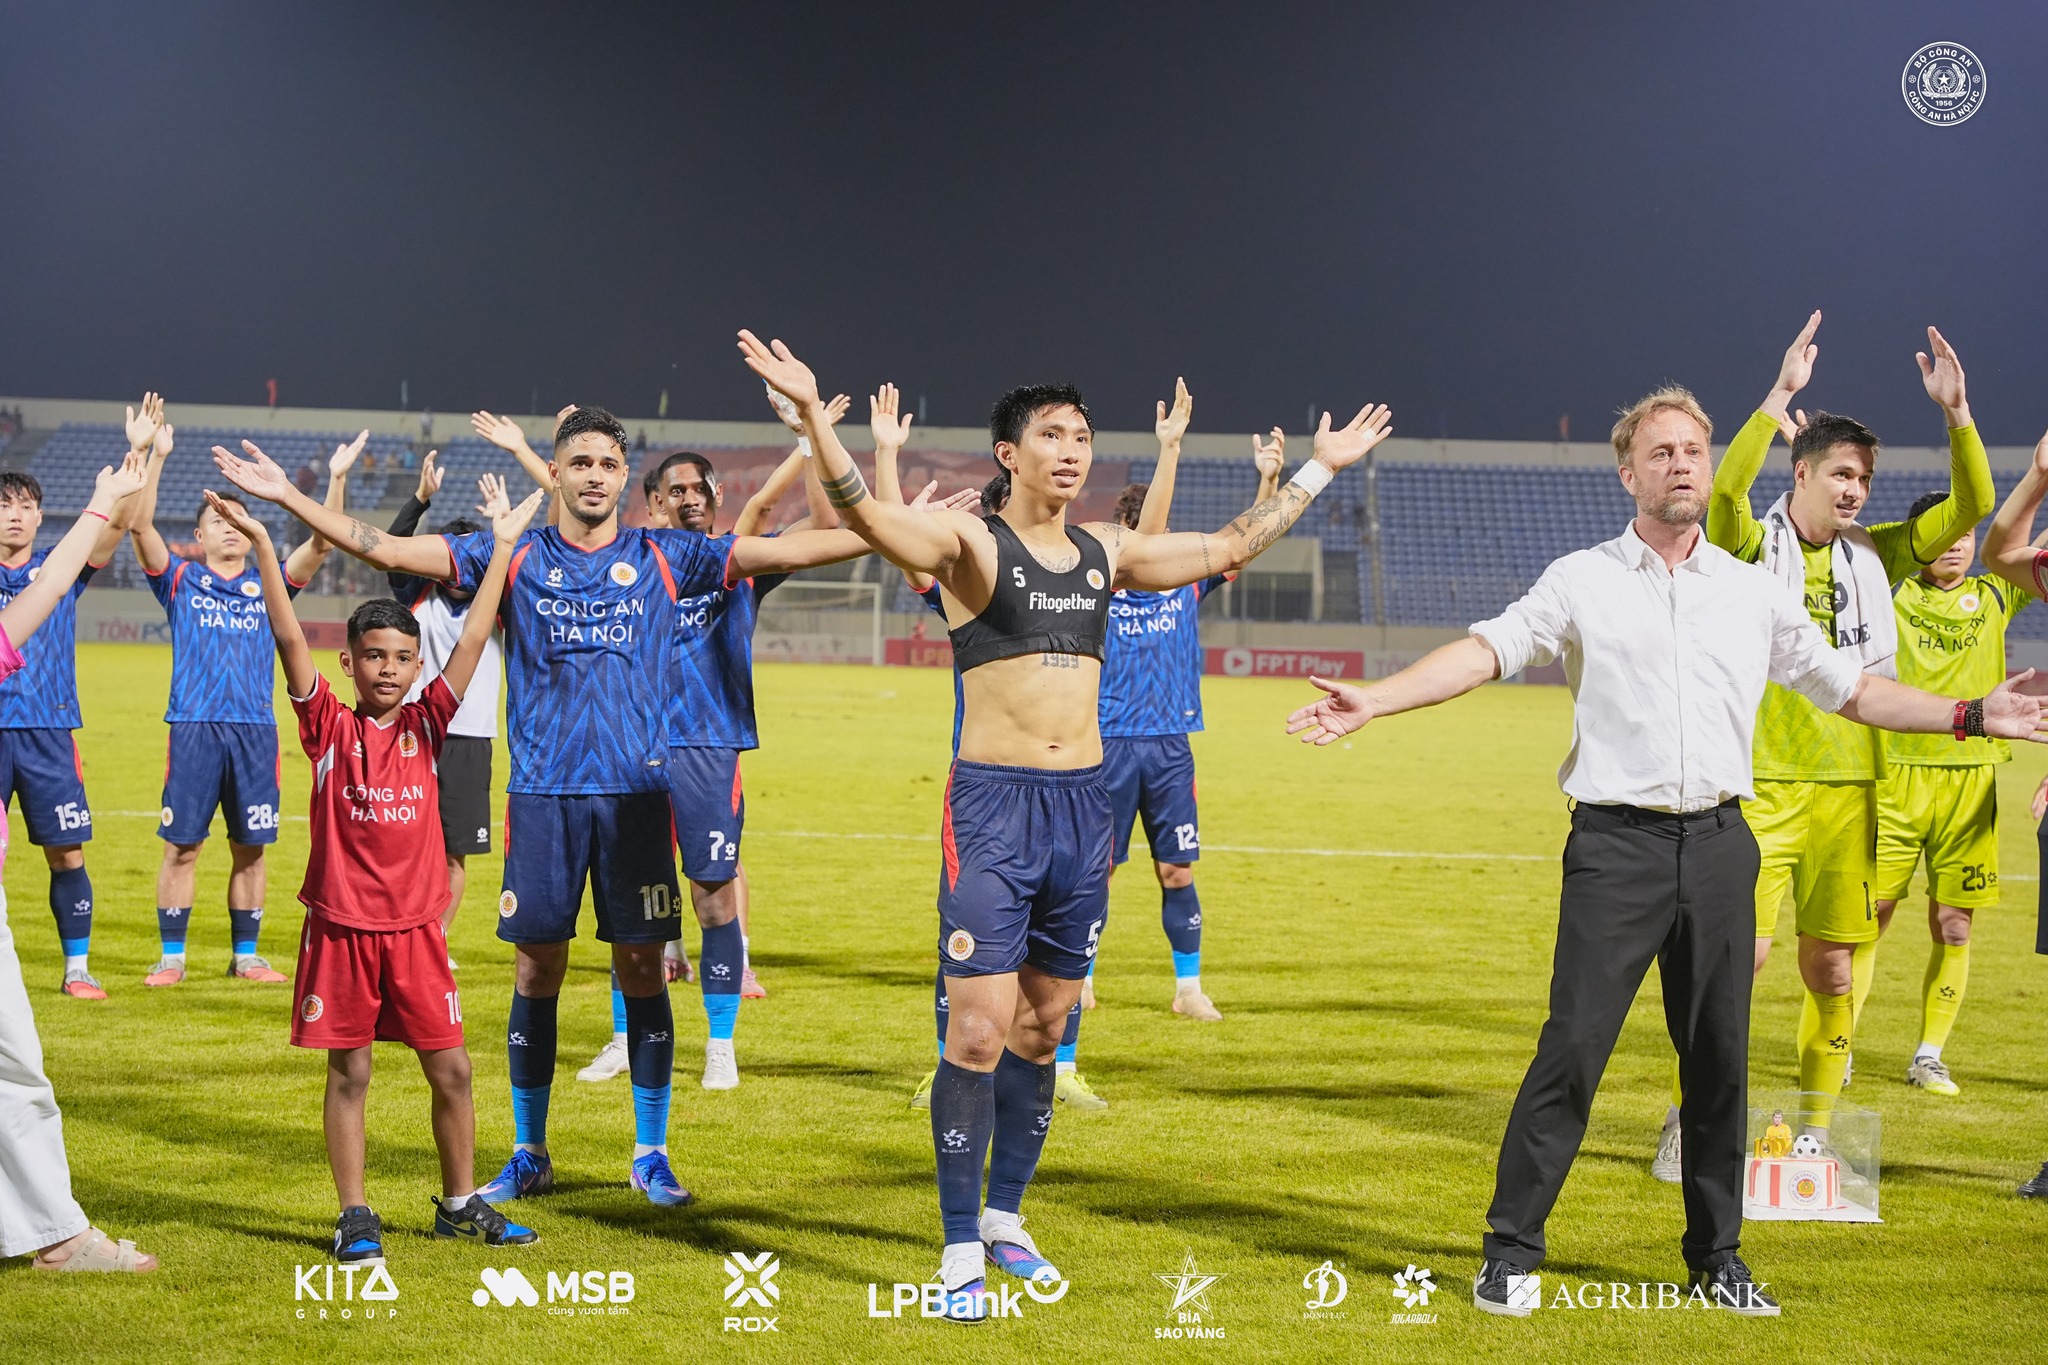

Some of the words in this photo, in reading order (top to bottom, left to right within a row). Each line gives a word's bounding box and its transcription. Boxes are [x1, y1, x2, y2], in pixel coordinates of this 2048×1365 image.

[1012, 566, 1026, 588] 5
[244, 600, 266, 614] AN
[536, 595, 606, 618] CÔNG
[614, 598, 645, 616] AN
[697, 590, 724, 605] AN
[1029, 592, 1096, 613] Fitogether
[1160, 598, 1182, 613] AN
[200, 612, 225, 628] HÀ
[230, 615, 259, 633] NỘI
[680, 608, 713, 628] NỘI
[1119, 618, 1144, 636] HÀ
[1146, 614, 1176, 634] NỘI
[550, 621, 584, 643] HÀ
[592, 620, 633, 647] NỘI
[1918, 634, 1945, 651] HÀ
[1255, 654, 1297, 673] FPT
[1301, 656, 1346, 678] Play
[342, 784, 395, 802] CÔNG
[400, 785, 424, 801] AN
[54, 802, 82, 831] 15
[247, 804, 273, 830] 28
[350, 804, 379, 822] HÀ
[383, 804, 416, 824] NỘI
[709, 831, 725, 860] 7
[1174, 823, 1198, 851] 12
[1962, 863, 1987, 892] 25
[638, 883, 672, 921] 10
[1085, 919, 1102, 958] 5
[444, 990, 462, 1025] 10
